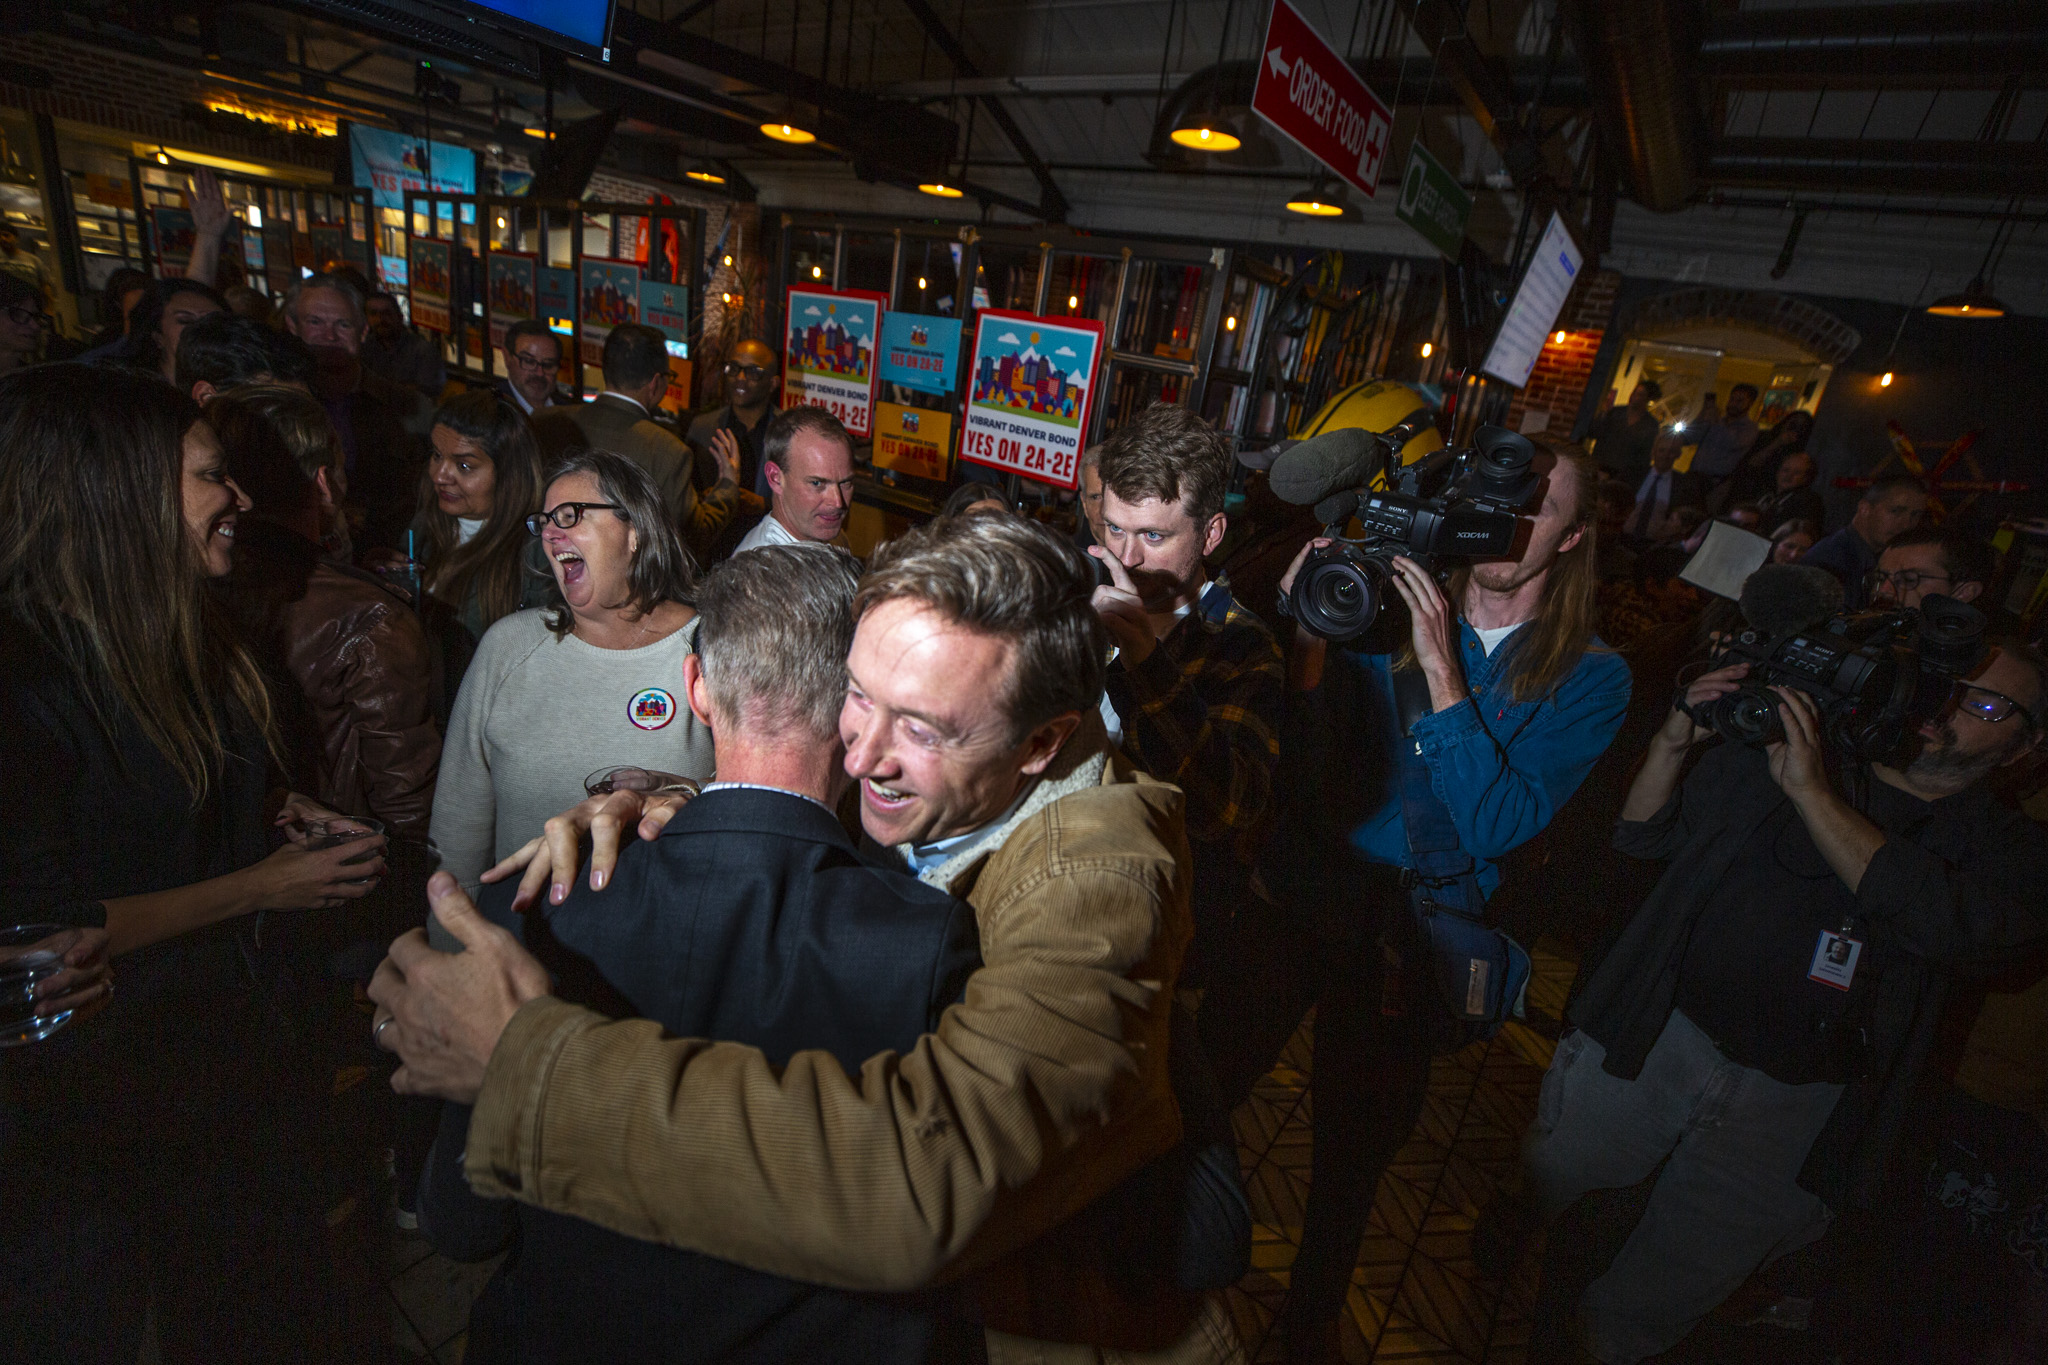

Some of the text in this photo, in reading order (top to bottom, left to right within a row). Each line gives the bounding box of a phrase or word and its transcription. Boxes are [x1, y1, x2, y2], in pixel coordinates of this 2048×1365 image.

[1288, 56, 1366, 157] ORDER FOOD
[890, 352, 944, 373] YES ON 2A-2E
[817, 384, 846, 397] DENVER
[846, 389, 868, 402] BOND
[831, 401, 867, 428] 2A-2E
[969, 414, 1077, 448] VIBRANT DENVER BOND
[881, 439, 896, 454] YES
[898, 442, 911, 457] ON
[967, 430, 1074, 478] YES ON 2A-2E
[1388, 505, 1408, 514] SONY
[1815, 646, 1836, 656] SONY
